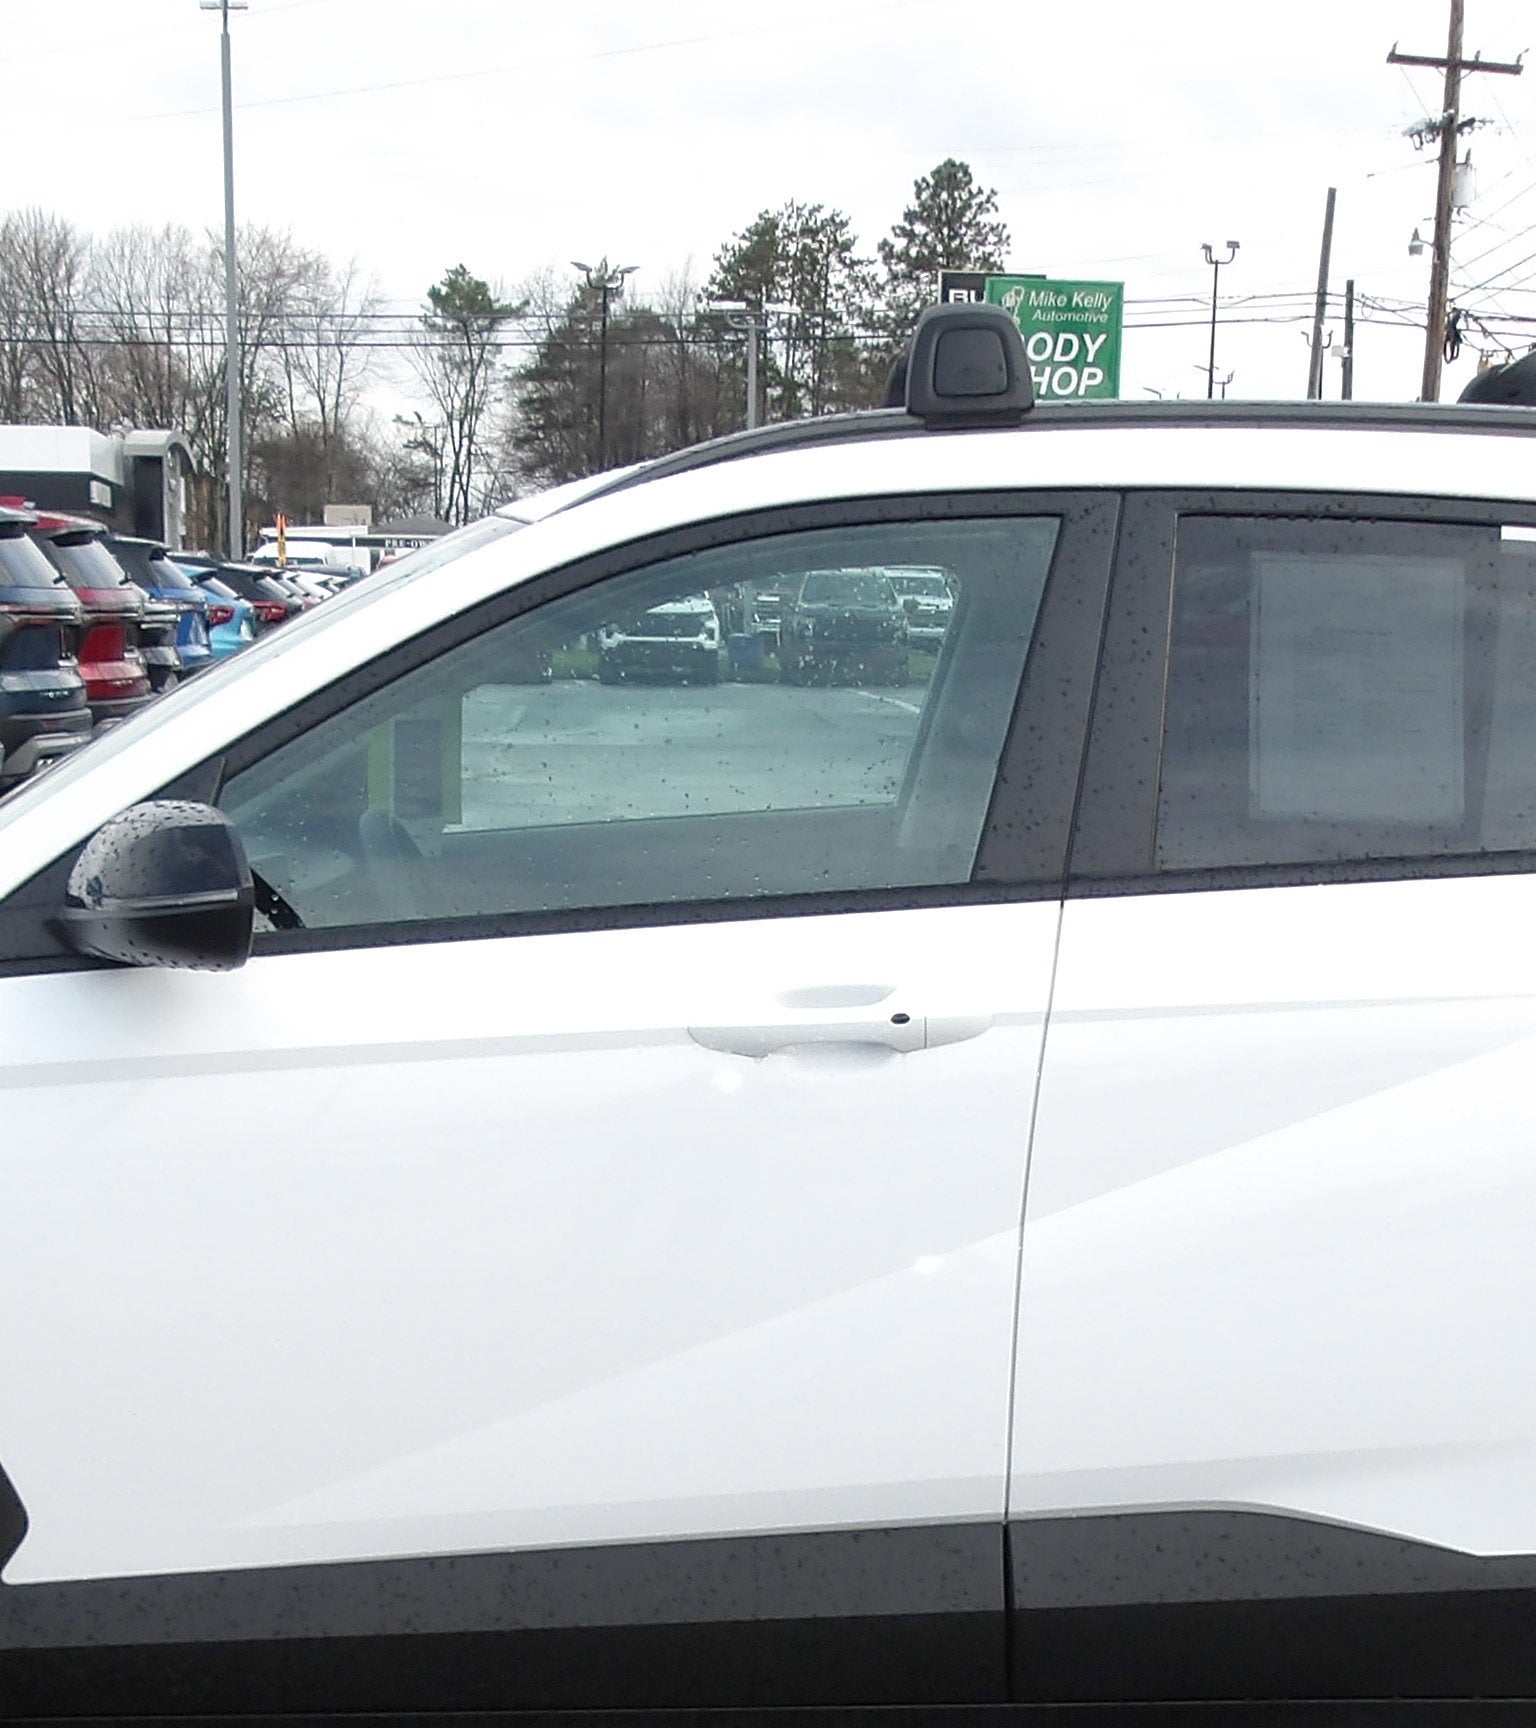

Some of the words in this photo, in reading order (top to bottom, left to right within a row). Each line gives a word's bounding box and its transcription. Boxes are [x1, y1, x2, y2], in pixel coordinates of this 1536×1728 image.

[1029, 290, 1065, 308] Mike
[1072, 291, 1112, 312] Kelly
[1032, 309, 1109, 323] Automotive
[1022, 331, 1108, 363] ODY
[1029, 365, 1104, 396] HOP
